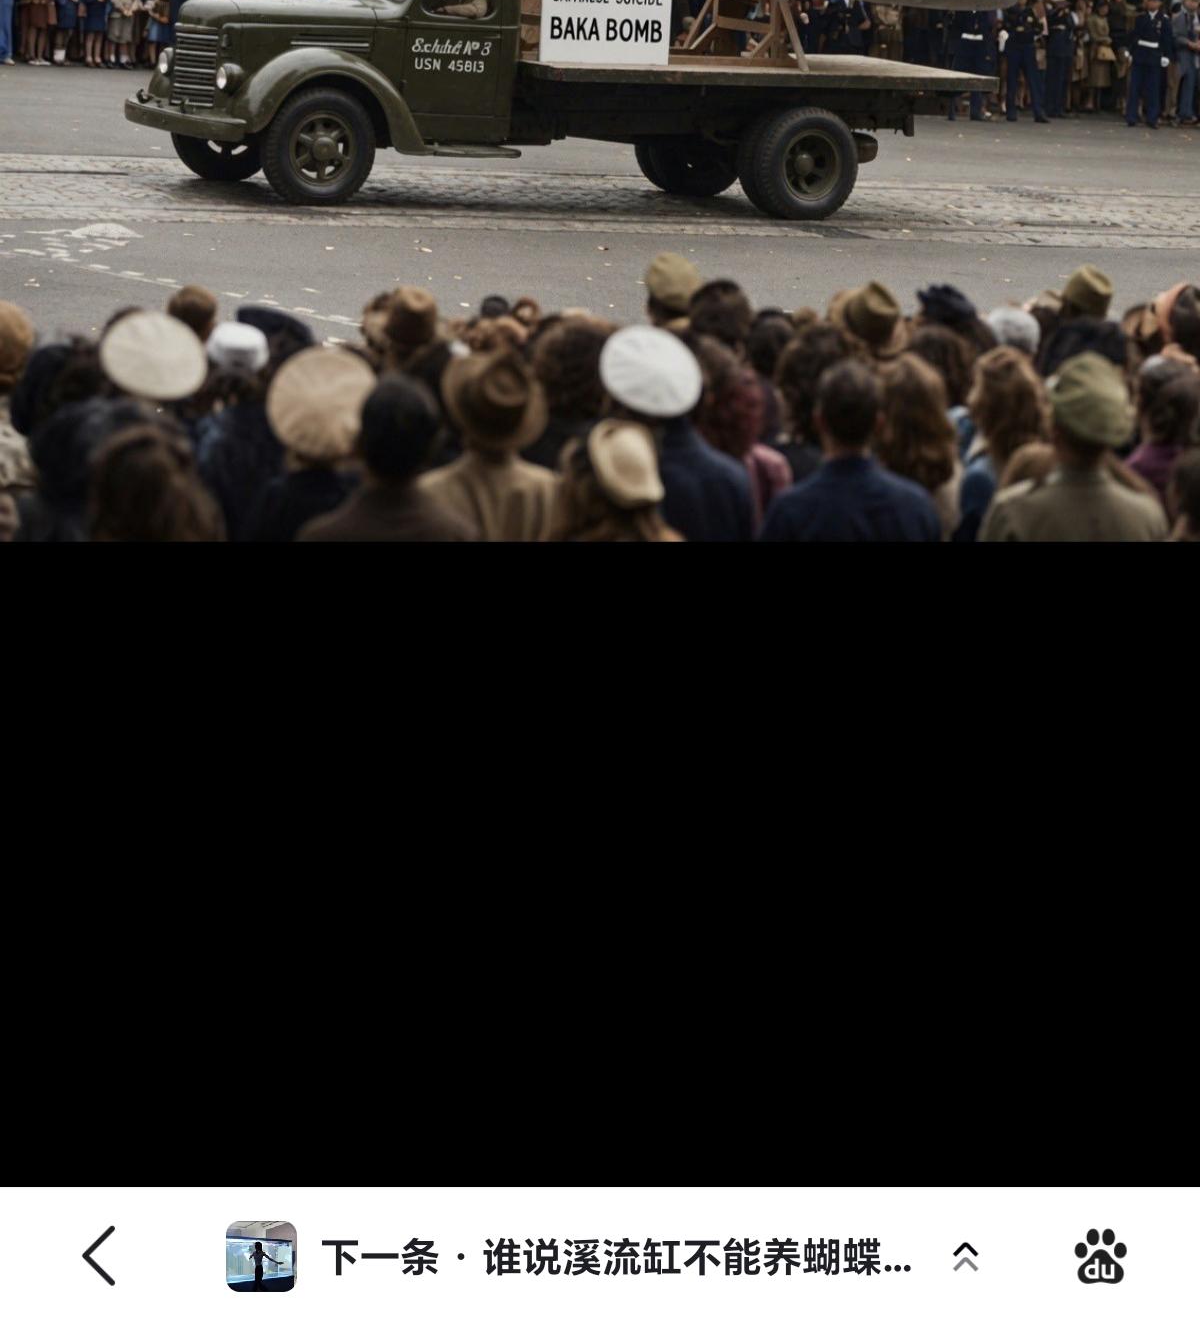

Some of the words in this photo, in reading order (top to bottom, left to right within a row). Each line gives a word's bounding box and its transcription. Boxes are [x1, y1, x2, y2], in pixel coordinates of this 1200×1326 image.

[550, 16, 601, 42] BAKA
[605, 18, 663, 44] BOMB
[415, 57, 442, 71] USN
[448, 60, 485, 73] 45813
[321, 1236, 440, 1277] 下一条
[1086, 1259, 1115, 1279] du
